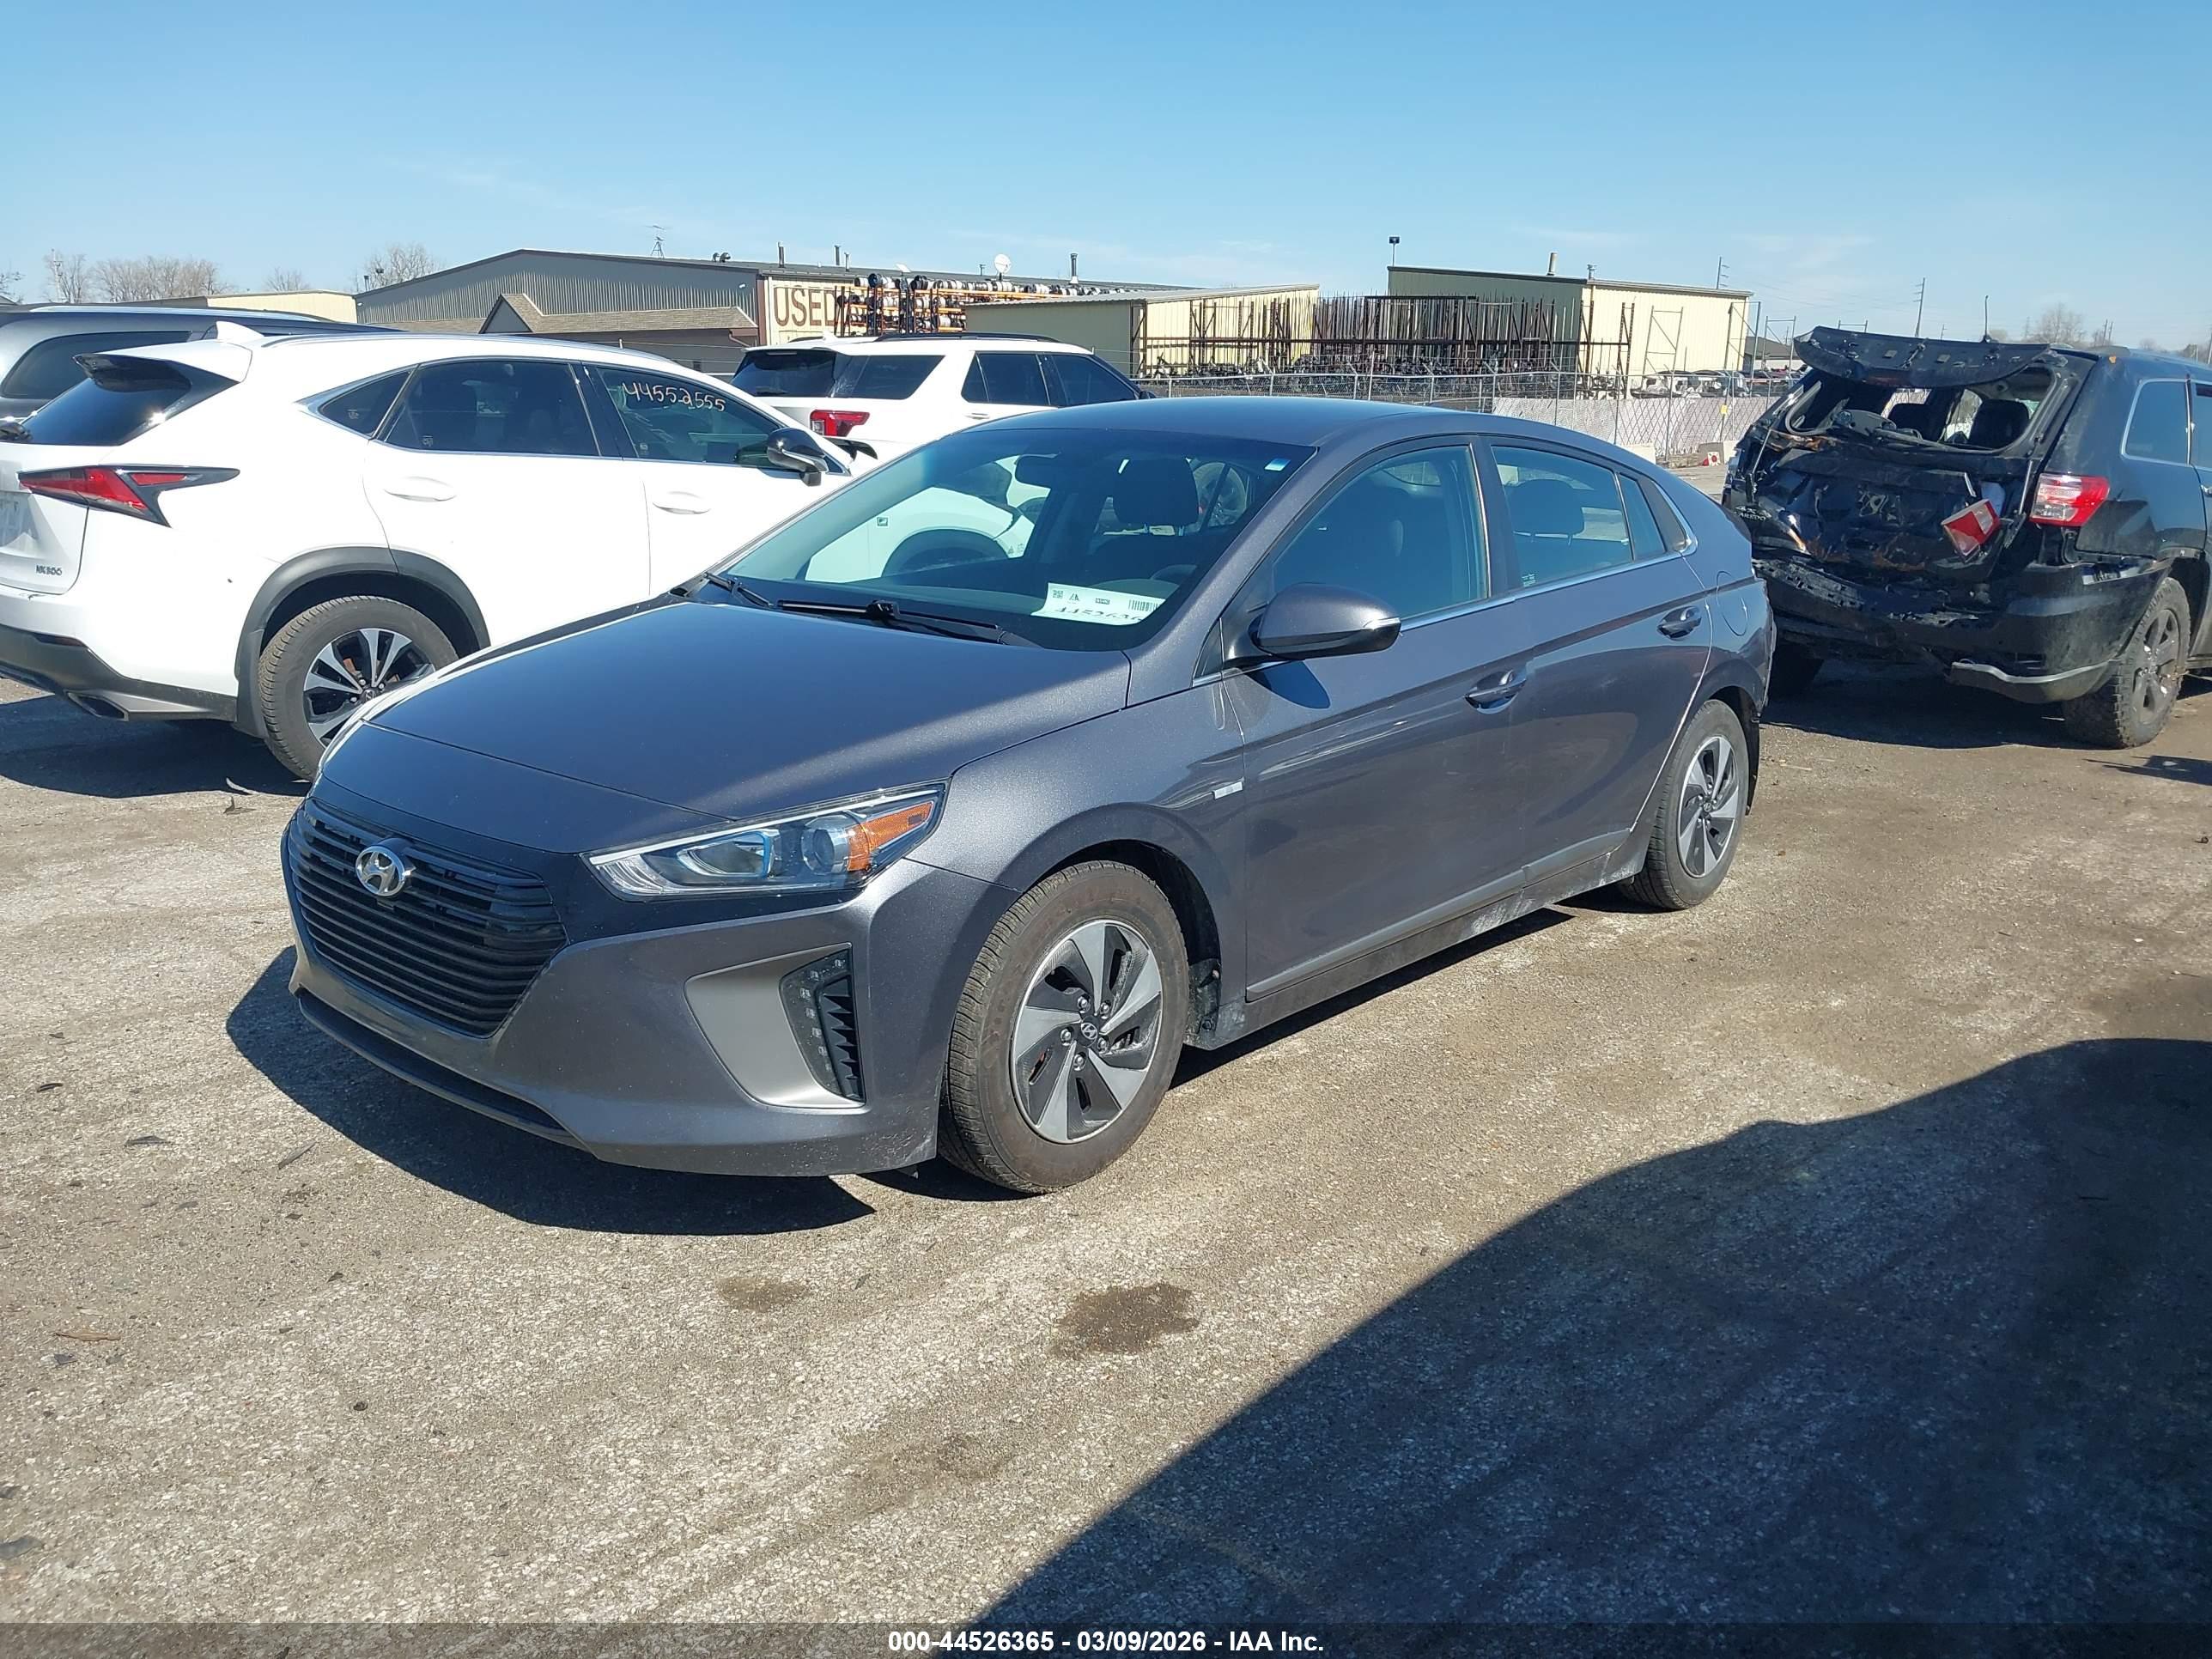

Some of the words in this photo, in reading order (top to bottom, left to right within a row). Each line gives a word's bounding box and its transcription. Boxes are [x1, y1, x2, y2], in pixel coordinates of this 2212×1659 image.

[773, 286, 837, 326] USED
[622, 382, 726, 411] 44552555
[1735, 512, 1766, 521] AREDO
